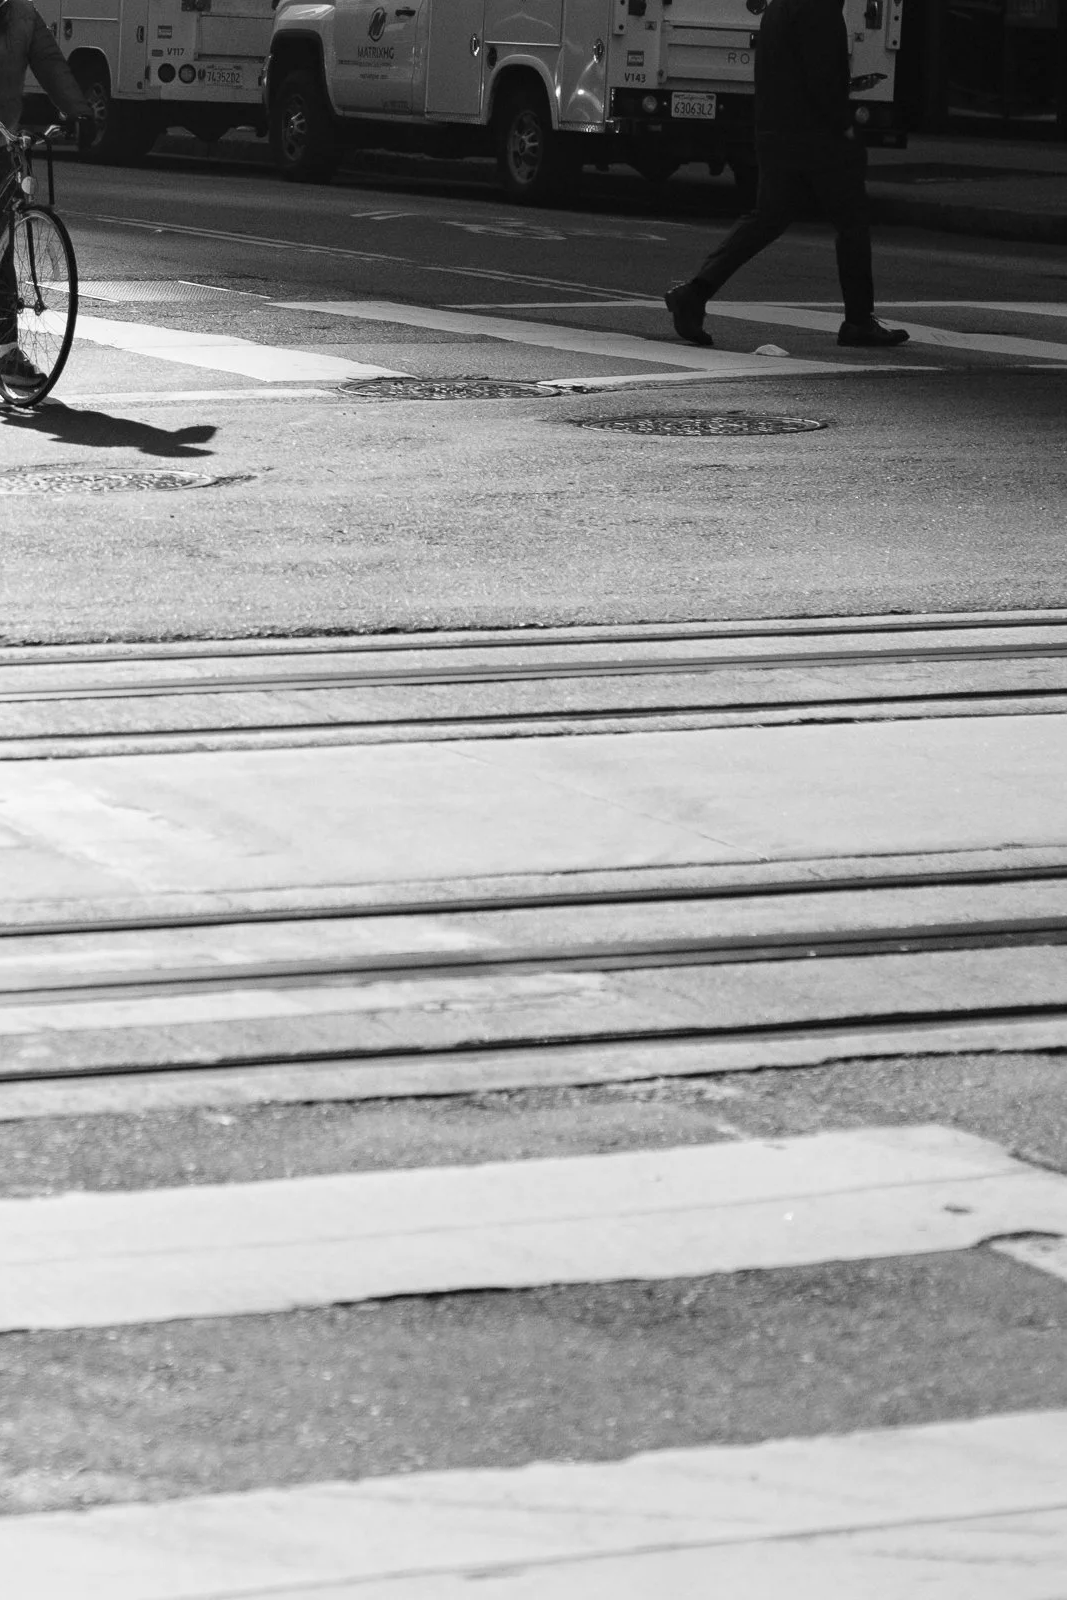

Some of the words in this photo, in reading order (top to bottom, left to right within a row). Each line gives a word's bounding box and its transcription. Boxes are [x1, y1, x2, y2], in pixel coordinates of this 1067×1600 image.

[167, 47, 185, 56] V117
[624, 72, 646, 83] V143
[674, 101, 713, 115] 63063L2
